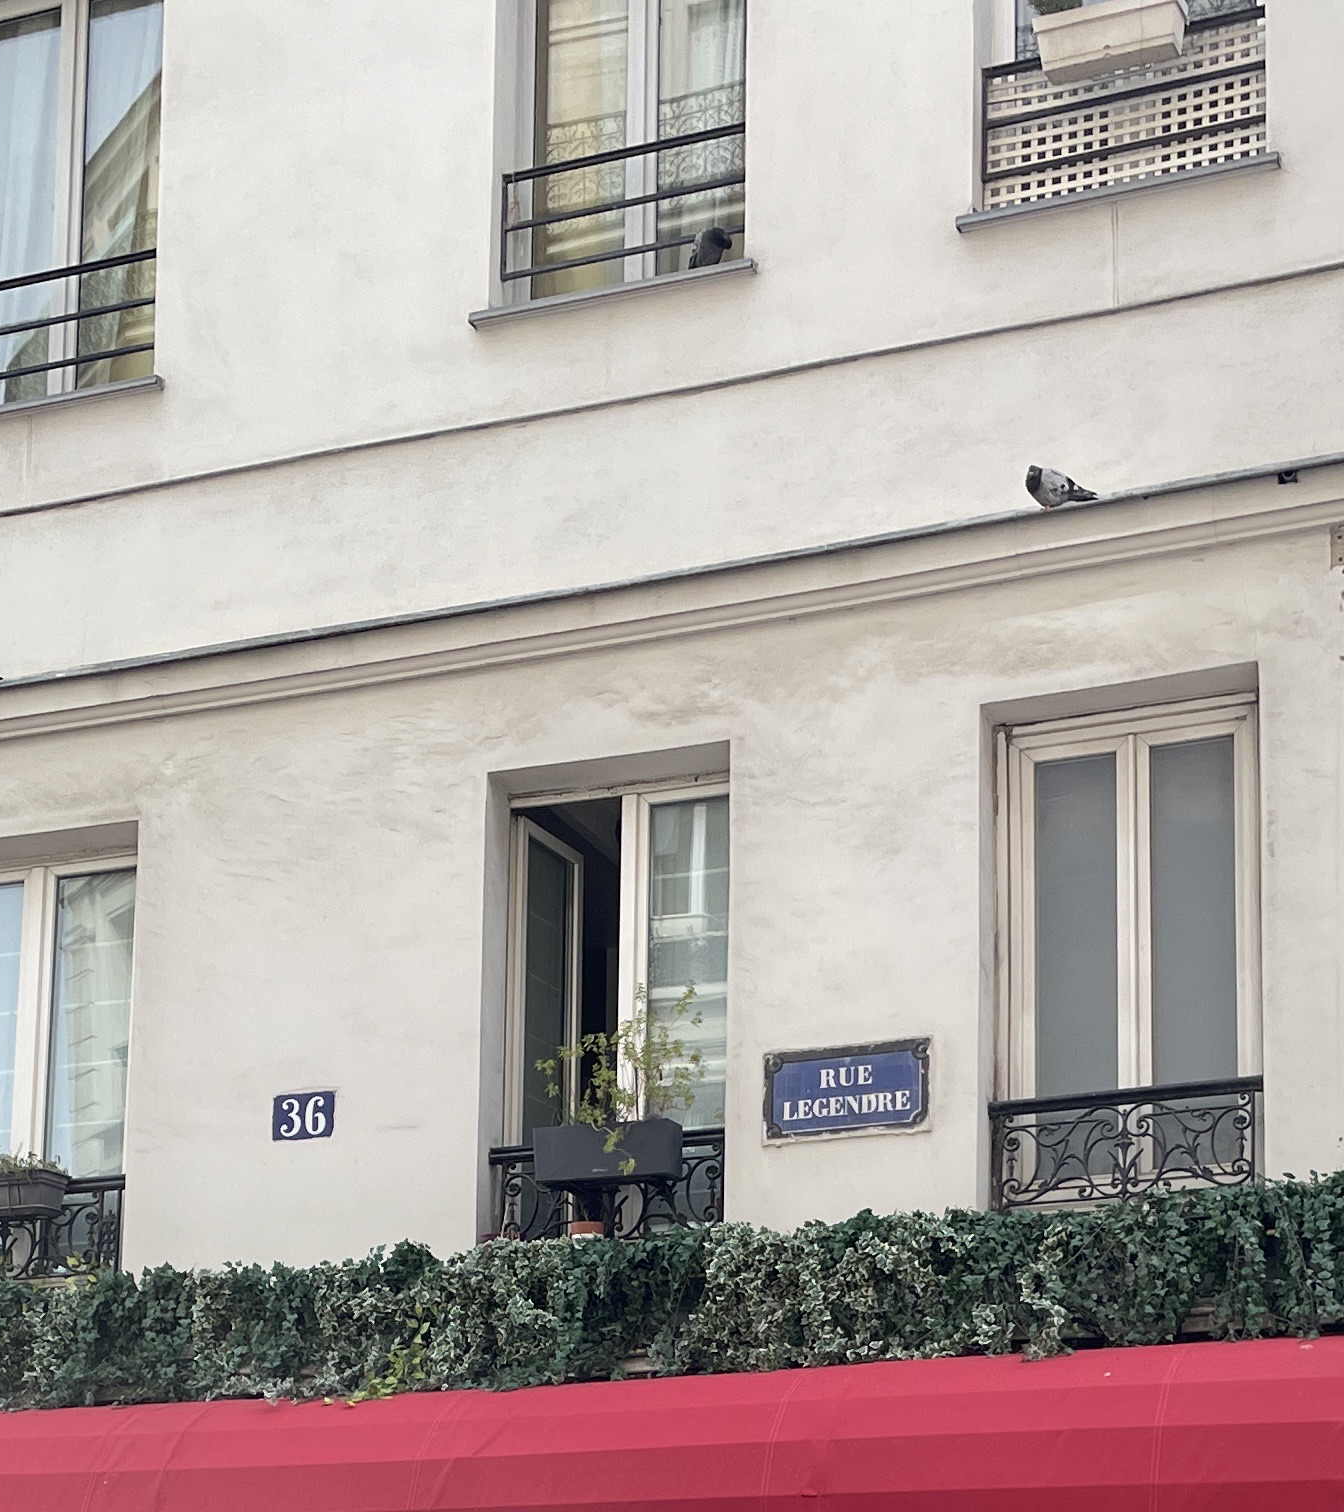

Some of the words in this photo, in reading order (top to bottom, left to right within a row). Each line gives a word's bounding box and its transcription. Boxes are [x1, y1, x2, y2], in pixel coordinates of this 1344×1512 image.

[818, 1064, 874, 1090] RUE
[279, 1095, 328, 1138] 36
[781, 1088, 912, 1122] LEGENDRE
